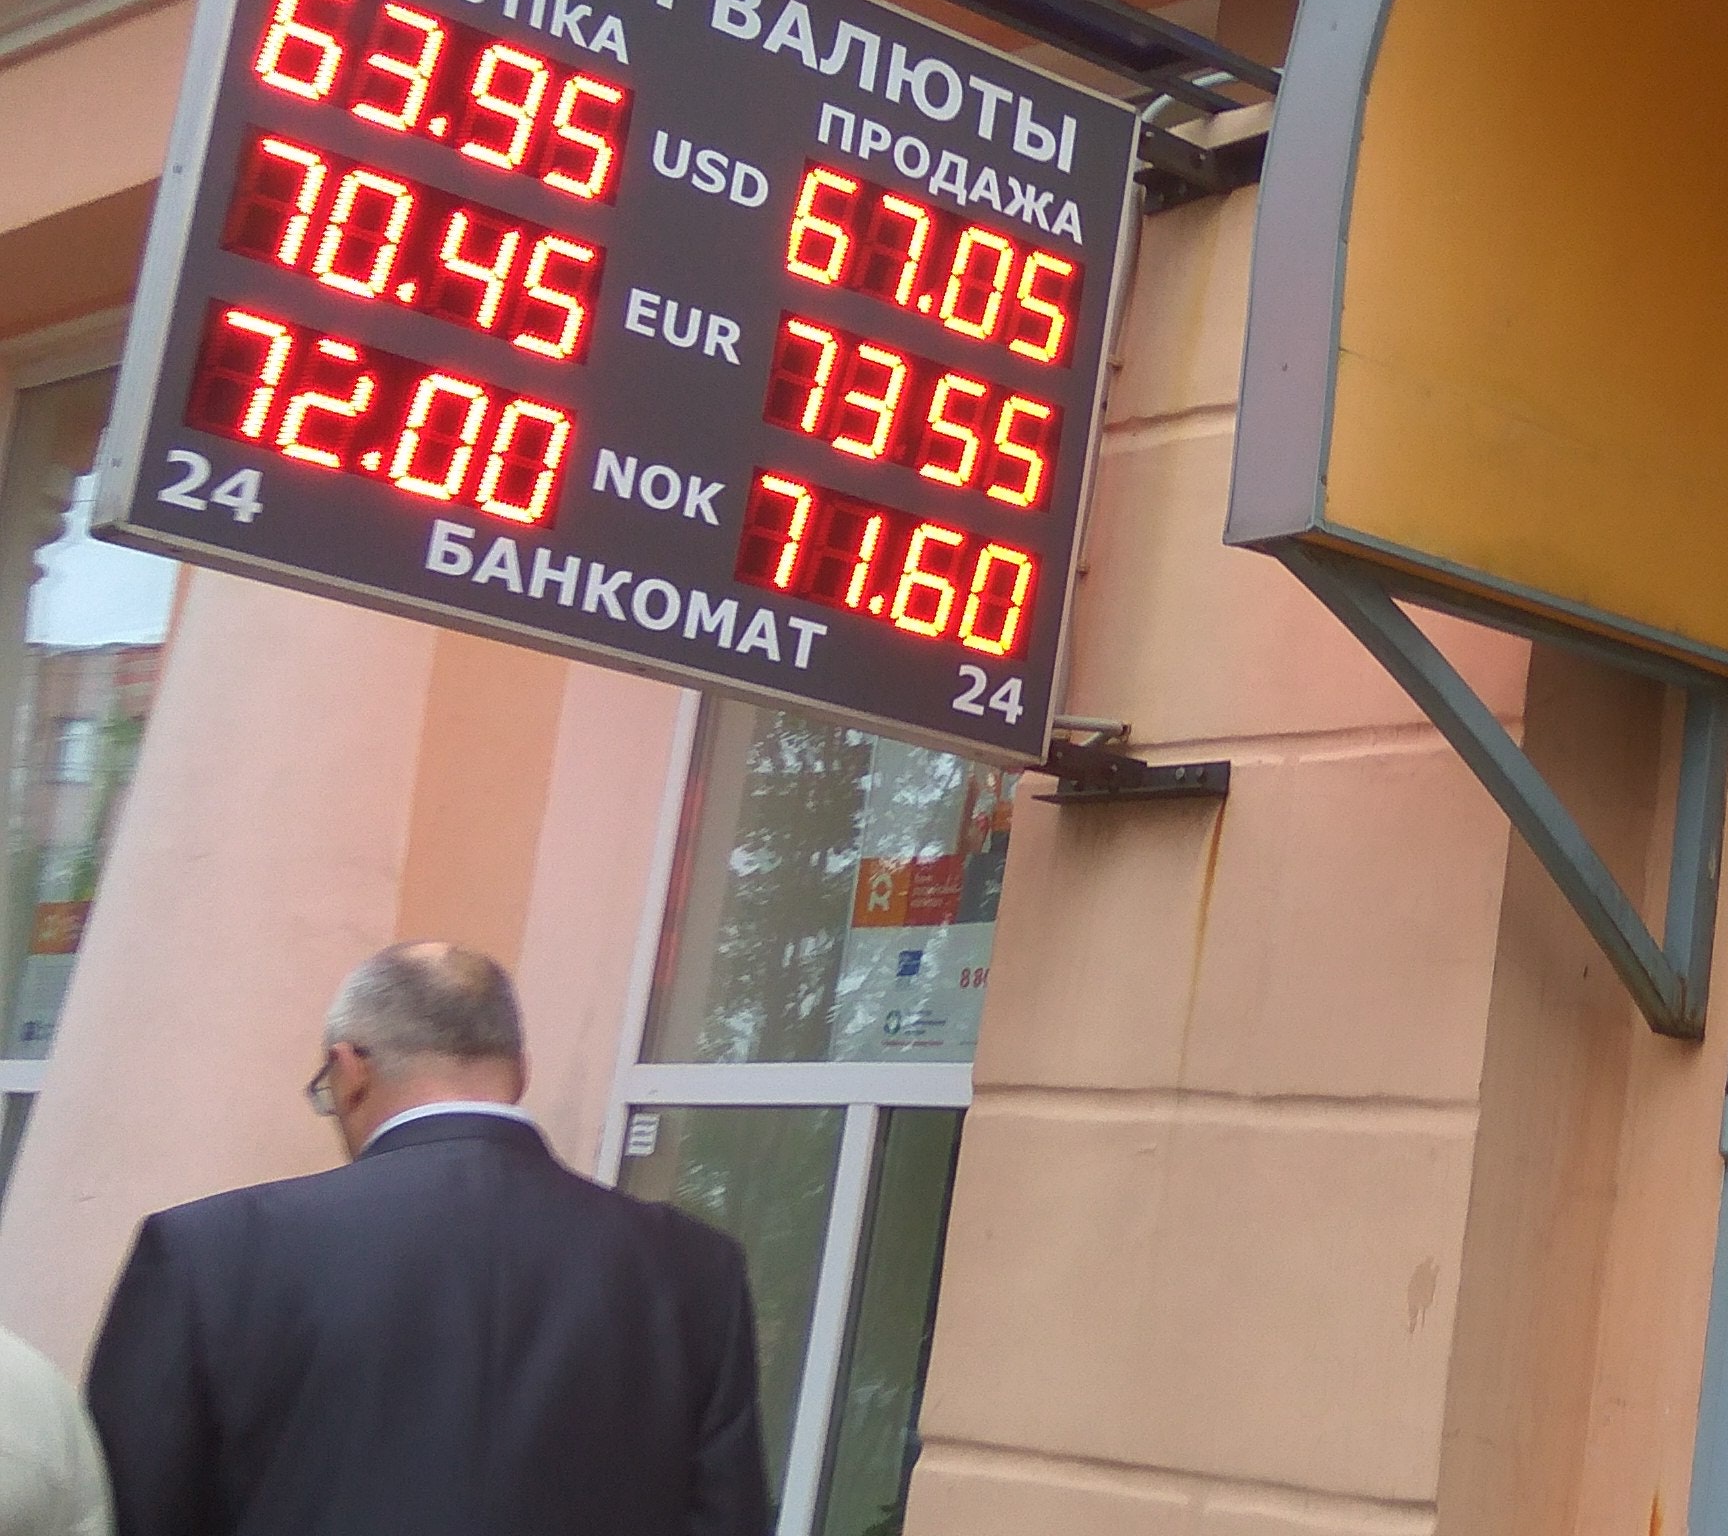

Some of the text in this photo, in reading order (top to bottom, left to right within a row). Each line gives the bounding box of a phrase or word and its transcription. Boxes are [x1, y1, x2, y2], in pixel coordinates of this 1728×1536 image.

[651, 130, 770, 207] USD
[816, 102, 1083, 245] ПРОДАЖА
[260, 137, 595, 360] 70.45
[786, 167, 1073, 363] 67.05
[625, 287, 742, 364] EUR
[157, 449, 264, 523] 24
[225, 309, 571, 524] 72.00
[592, 447, 726, 526] NOK
[424, 518, 828, 669] БАНКОМАТ
[761, 473, 1033, 656] 71.60
[951, 665, 1025, 726] 24
